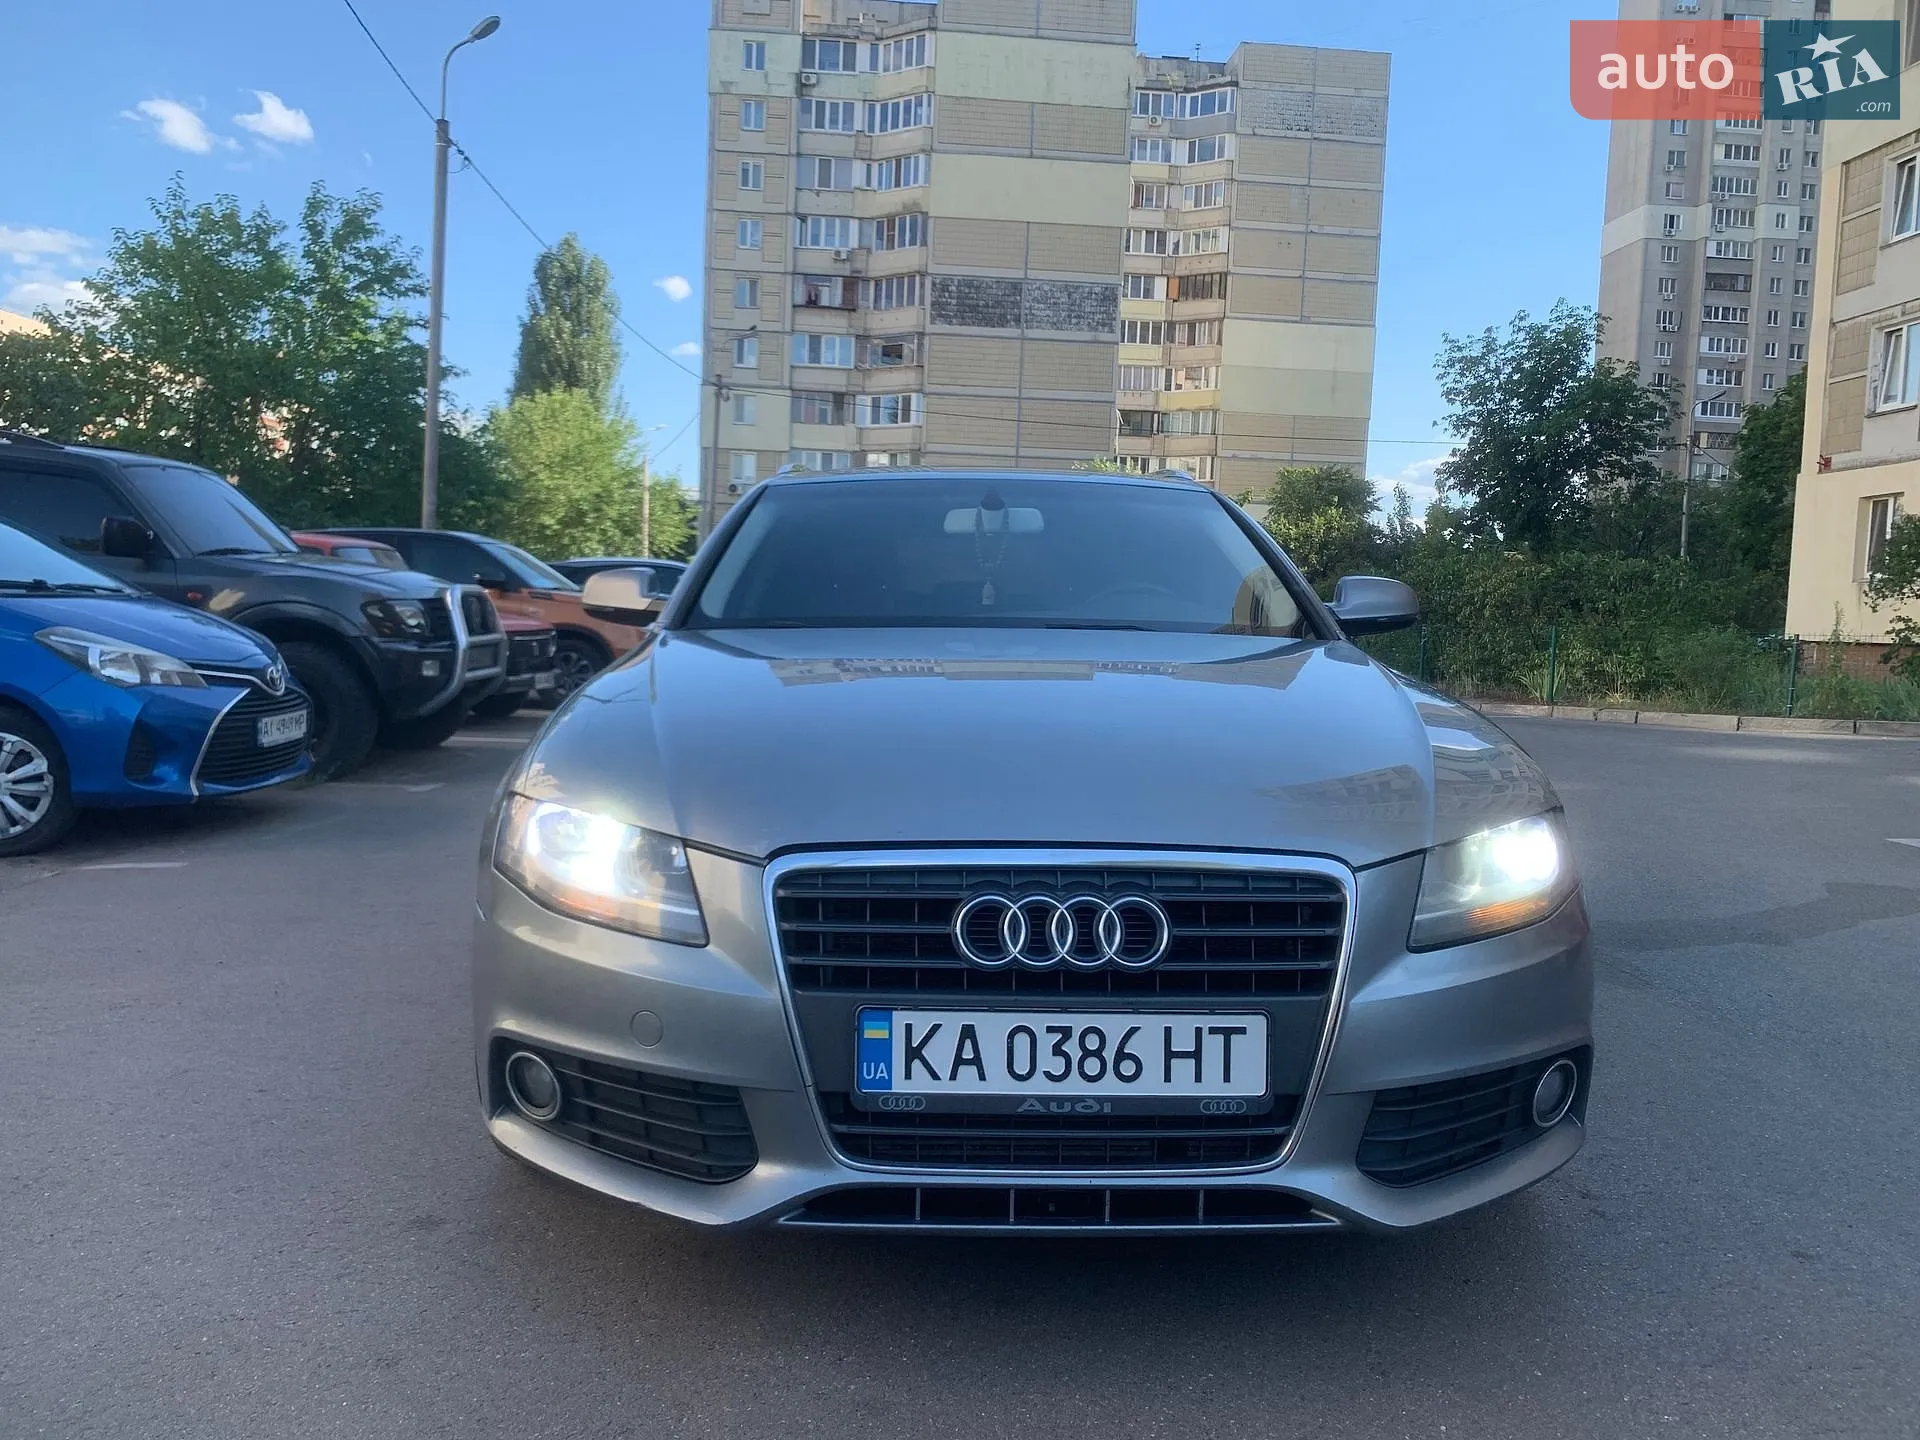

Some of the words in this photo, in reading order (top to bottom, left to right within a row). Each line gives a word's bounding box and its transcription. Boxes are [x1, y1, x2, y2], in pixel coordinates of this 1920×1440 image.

[903, 1022, 988, 1081] KA
[1006, 1025, 1144, 1084] 0386
[1163, 1025, 1248, 1084] HT
[863, 1061, 889, 1080] UA
[1016, 1098, 1112, 1114] Audi
